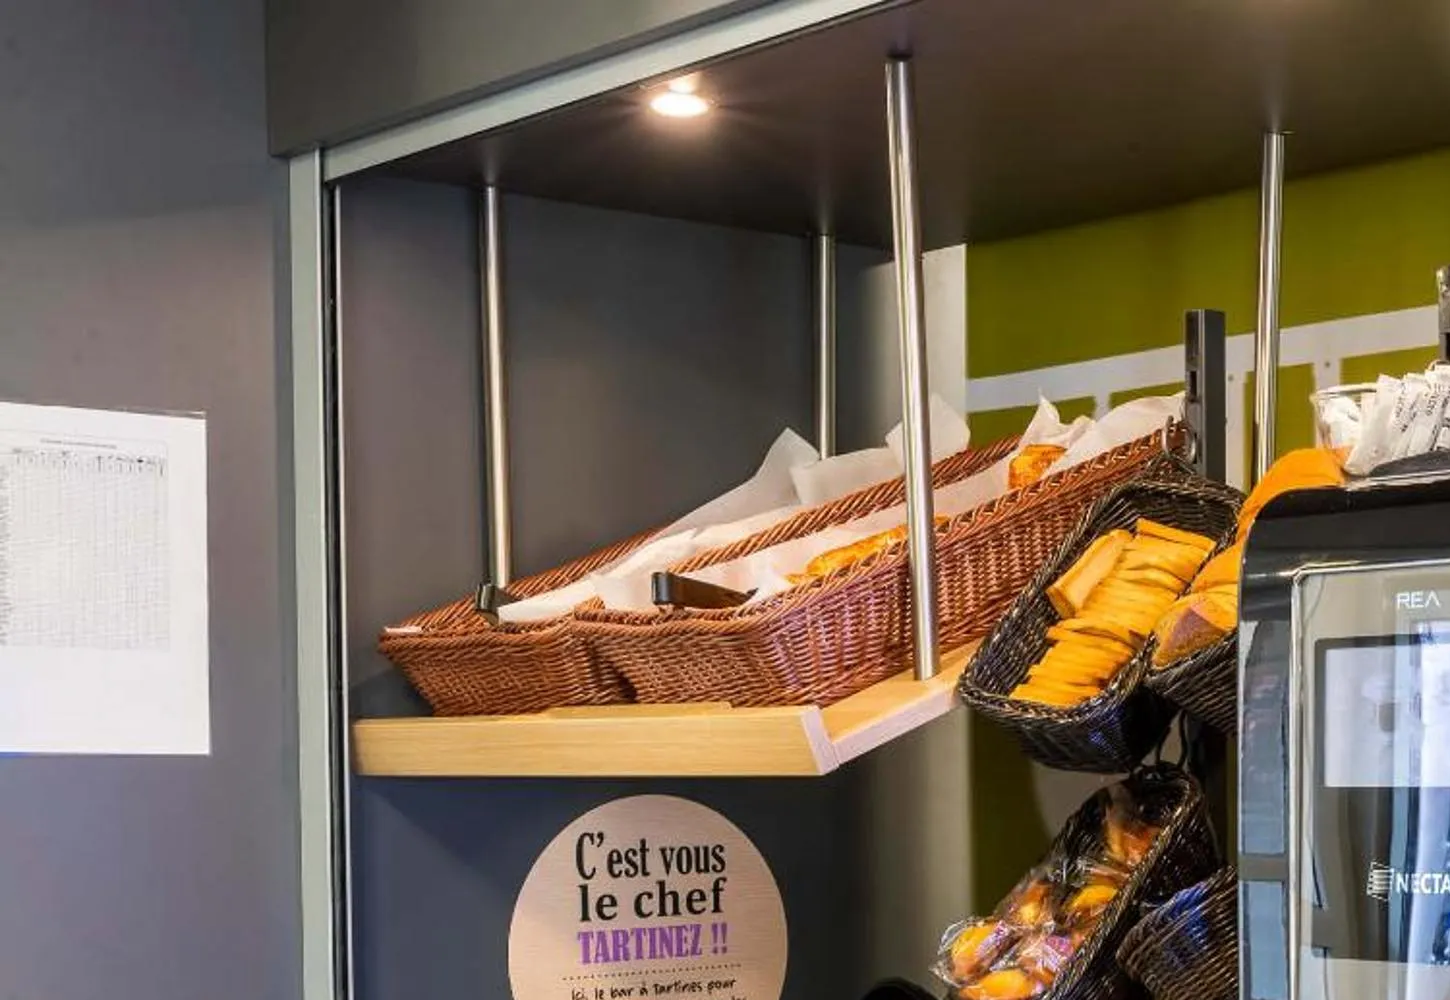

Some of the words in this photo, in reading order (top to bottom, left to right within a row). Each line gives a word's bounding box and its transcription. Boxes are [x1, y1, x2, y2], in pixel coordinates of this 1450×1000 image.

[1397, 590, 1441, 609] REA
[575, 831, 650, 881] C'est
[659, 843, 726, 876] vous
[579, 884, 618, 922] le
[634, 876, 728, 919] chef
[577, 923, 702, 965] TARTINEZ
[710, 922, 728, 955] !!
[594, 986, 604, 1000] le
[610, 986, 632, 1000] bar
[707, 979, 736, 995] pour
